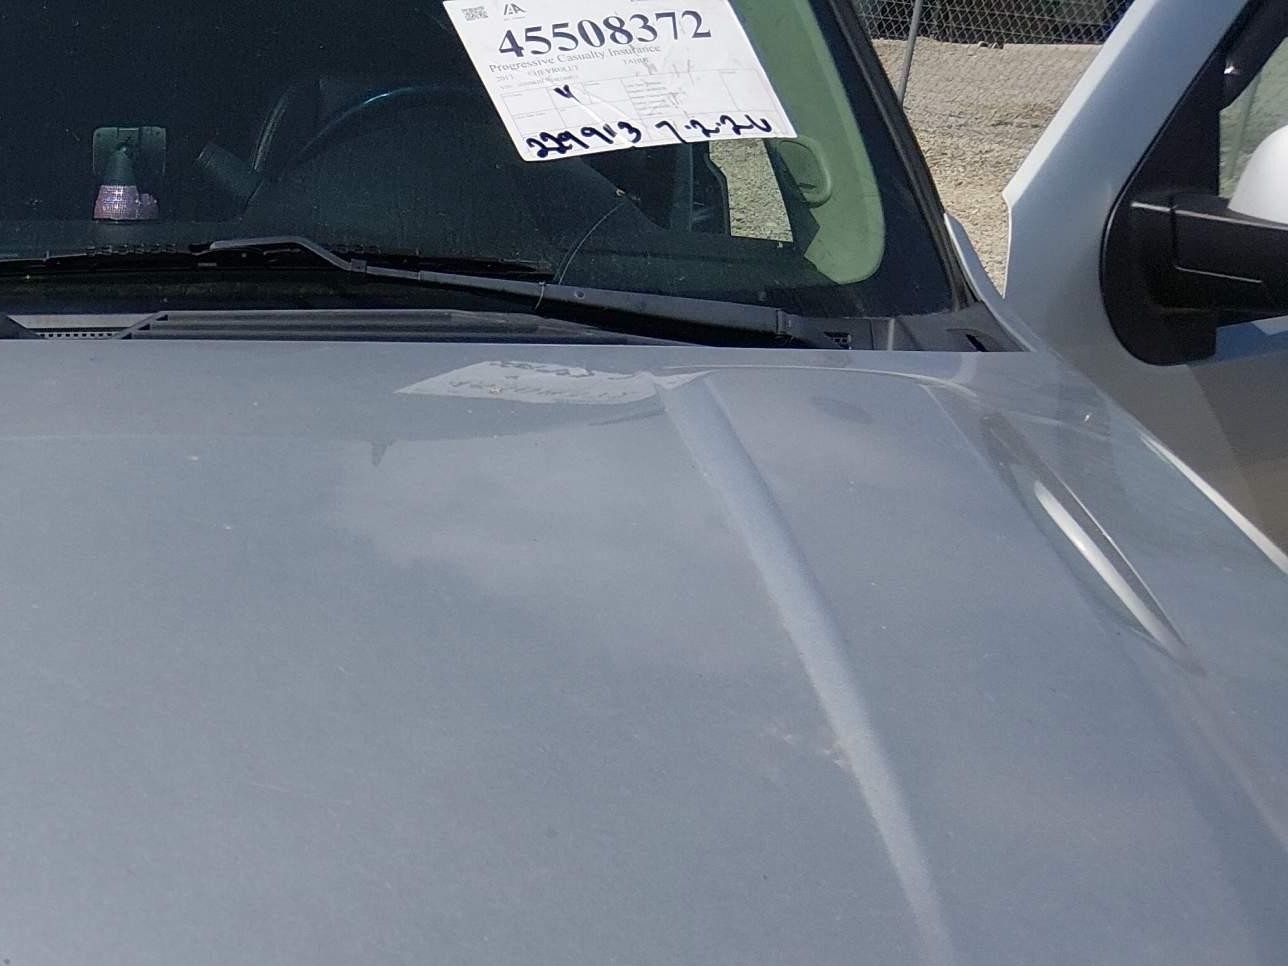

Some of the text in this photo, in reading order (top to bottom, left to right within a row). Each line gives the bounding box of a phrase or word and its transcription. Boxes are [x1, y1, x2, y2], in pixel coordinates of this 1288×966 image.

[498, 9, 712, 58] 45508372
[488, 44, 661, 73] Progressive Casualty Insurance
